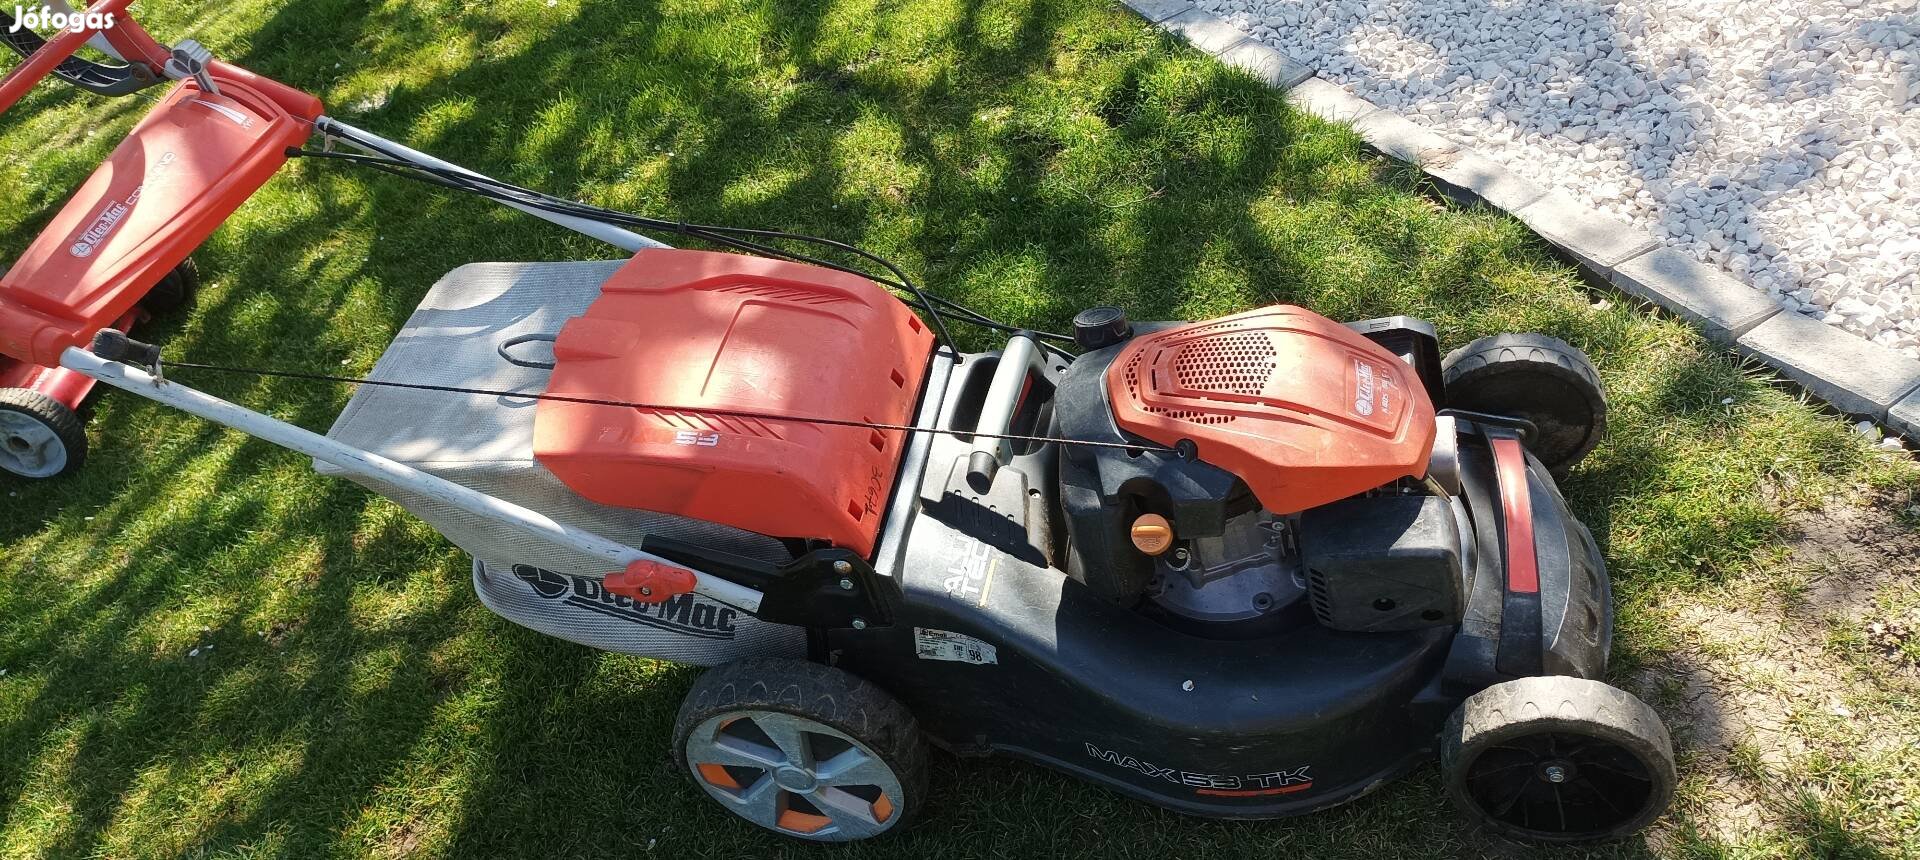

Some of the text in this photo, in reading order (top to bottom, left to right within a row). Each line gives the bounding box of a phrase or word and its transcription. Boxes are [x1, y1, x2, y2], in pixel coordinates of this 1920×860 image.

[674, 431, 720, 447] 53
[969, 649, 983, 662] 98
[1085, 742, 1312, 789] MAX 53 TK
